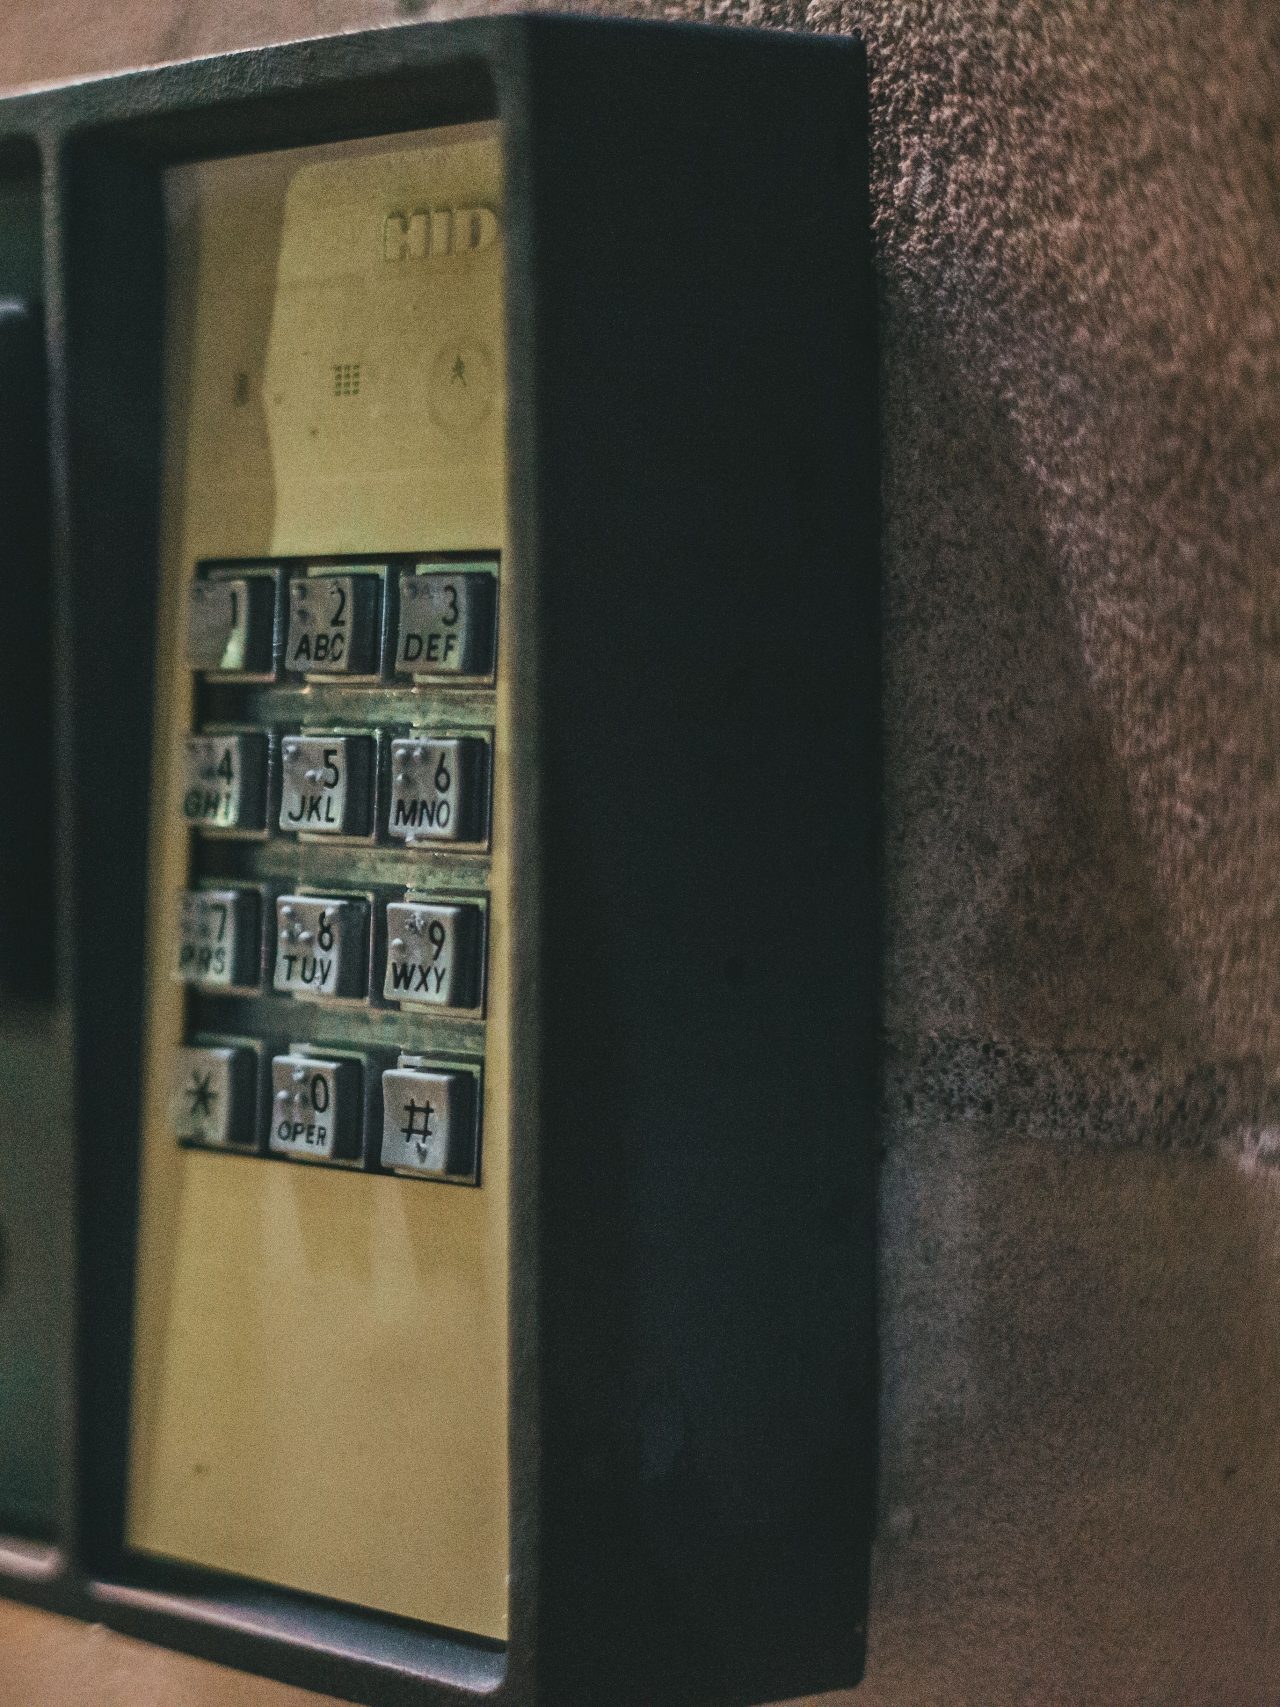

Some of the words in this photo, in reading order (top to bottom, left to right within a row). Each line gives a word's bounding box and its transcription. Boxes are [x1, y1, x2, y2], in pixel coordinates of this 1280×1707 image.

[384, 207, 500, 262] HID
[229, 592, 238, 628] 1
[330, 583, 346, 627] 2
[442, 585, 459, 626] 3
[294, 633, 346, 662] ABC
[403, 633, 459, 662] DEF
[216, 748, 234, 785] 4
[323, 749, 340, 789] 5
[434, 752, 451, 793] 6
[183, 791, 232, 820] GHI
[288, 796, 336, 822] JKL
[394, 799, 451, 828] MNO
[209, 905, 227, 942] 7
[317, 911, 334, 952] 8
[428, 920, 446, 961] 9
[283, 954, 332, 985] TUV
[391, 962, 447, 993] WXY
[310, 1073, 329, 1113] 0
[277, 1122, 328, 1146] OPER
